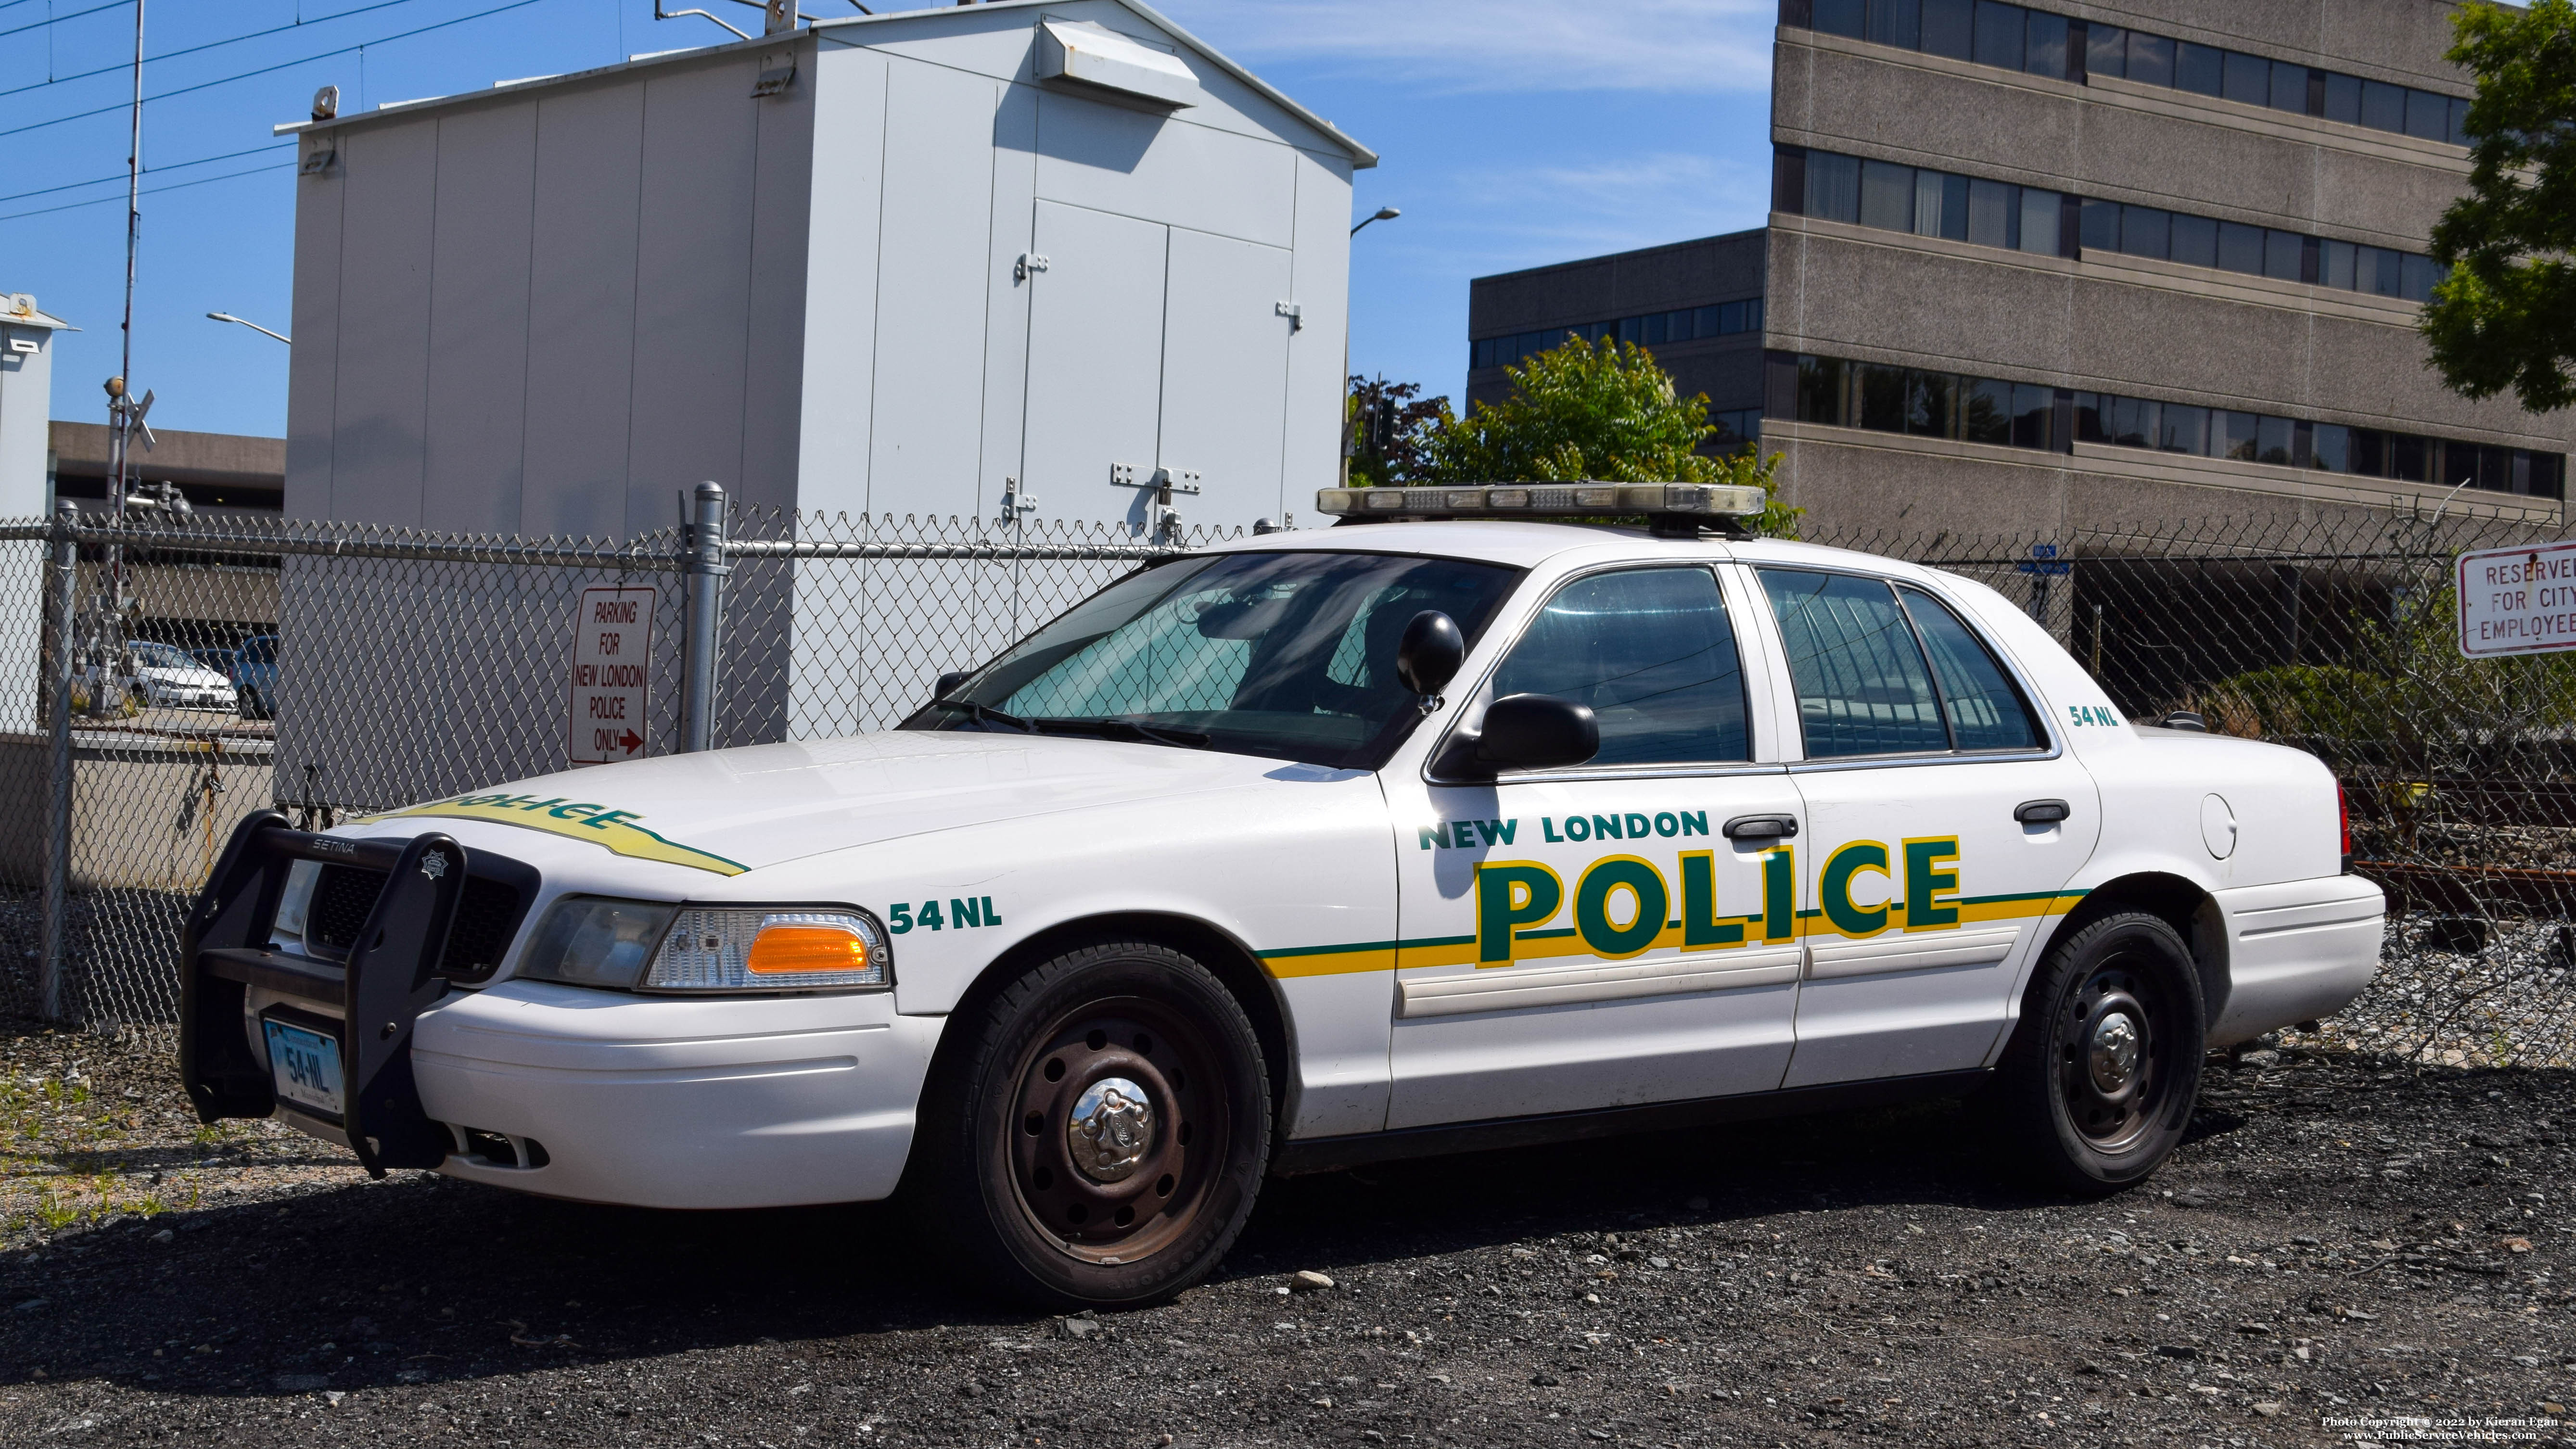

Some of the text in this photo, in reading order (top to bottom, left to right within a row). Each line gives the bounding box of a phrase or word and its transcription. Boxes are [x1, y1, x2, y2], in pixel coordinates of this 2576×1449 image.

[594, 601, 637, 623] PARKING
[2492, 591, 2526, 612] FOR
[599, 633, 620, 655] FOR
[575, 665, 643, 687] NEW LONDON
[590, 697, 625, 719] POLICE
[2069, 706, 2118, 727] 54 NL
[595, 728, 619, 751] ONLY
[421, 794, 647, 830] POLICE
[1417, 811, 1709, 850] NEW LONDON
[313, 839, 355, 854] SETINA
[1473, 834, 1961, 969] POLICE
[890, 896, 1002, 934] 54 NL
